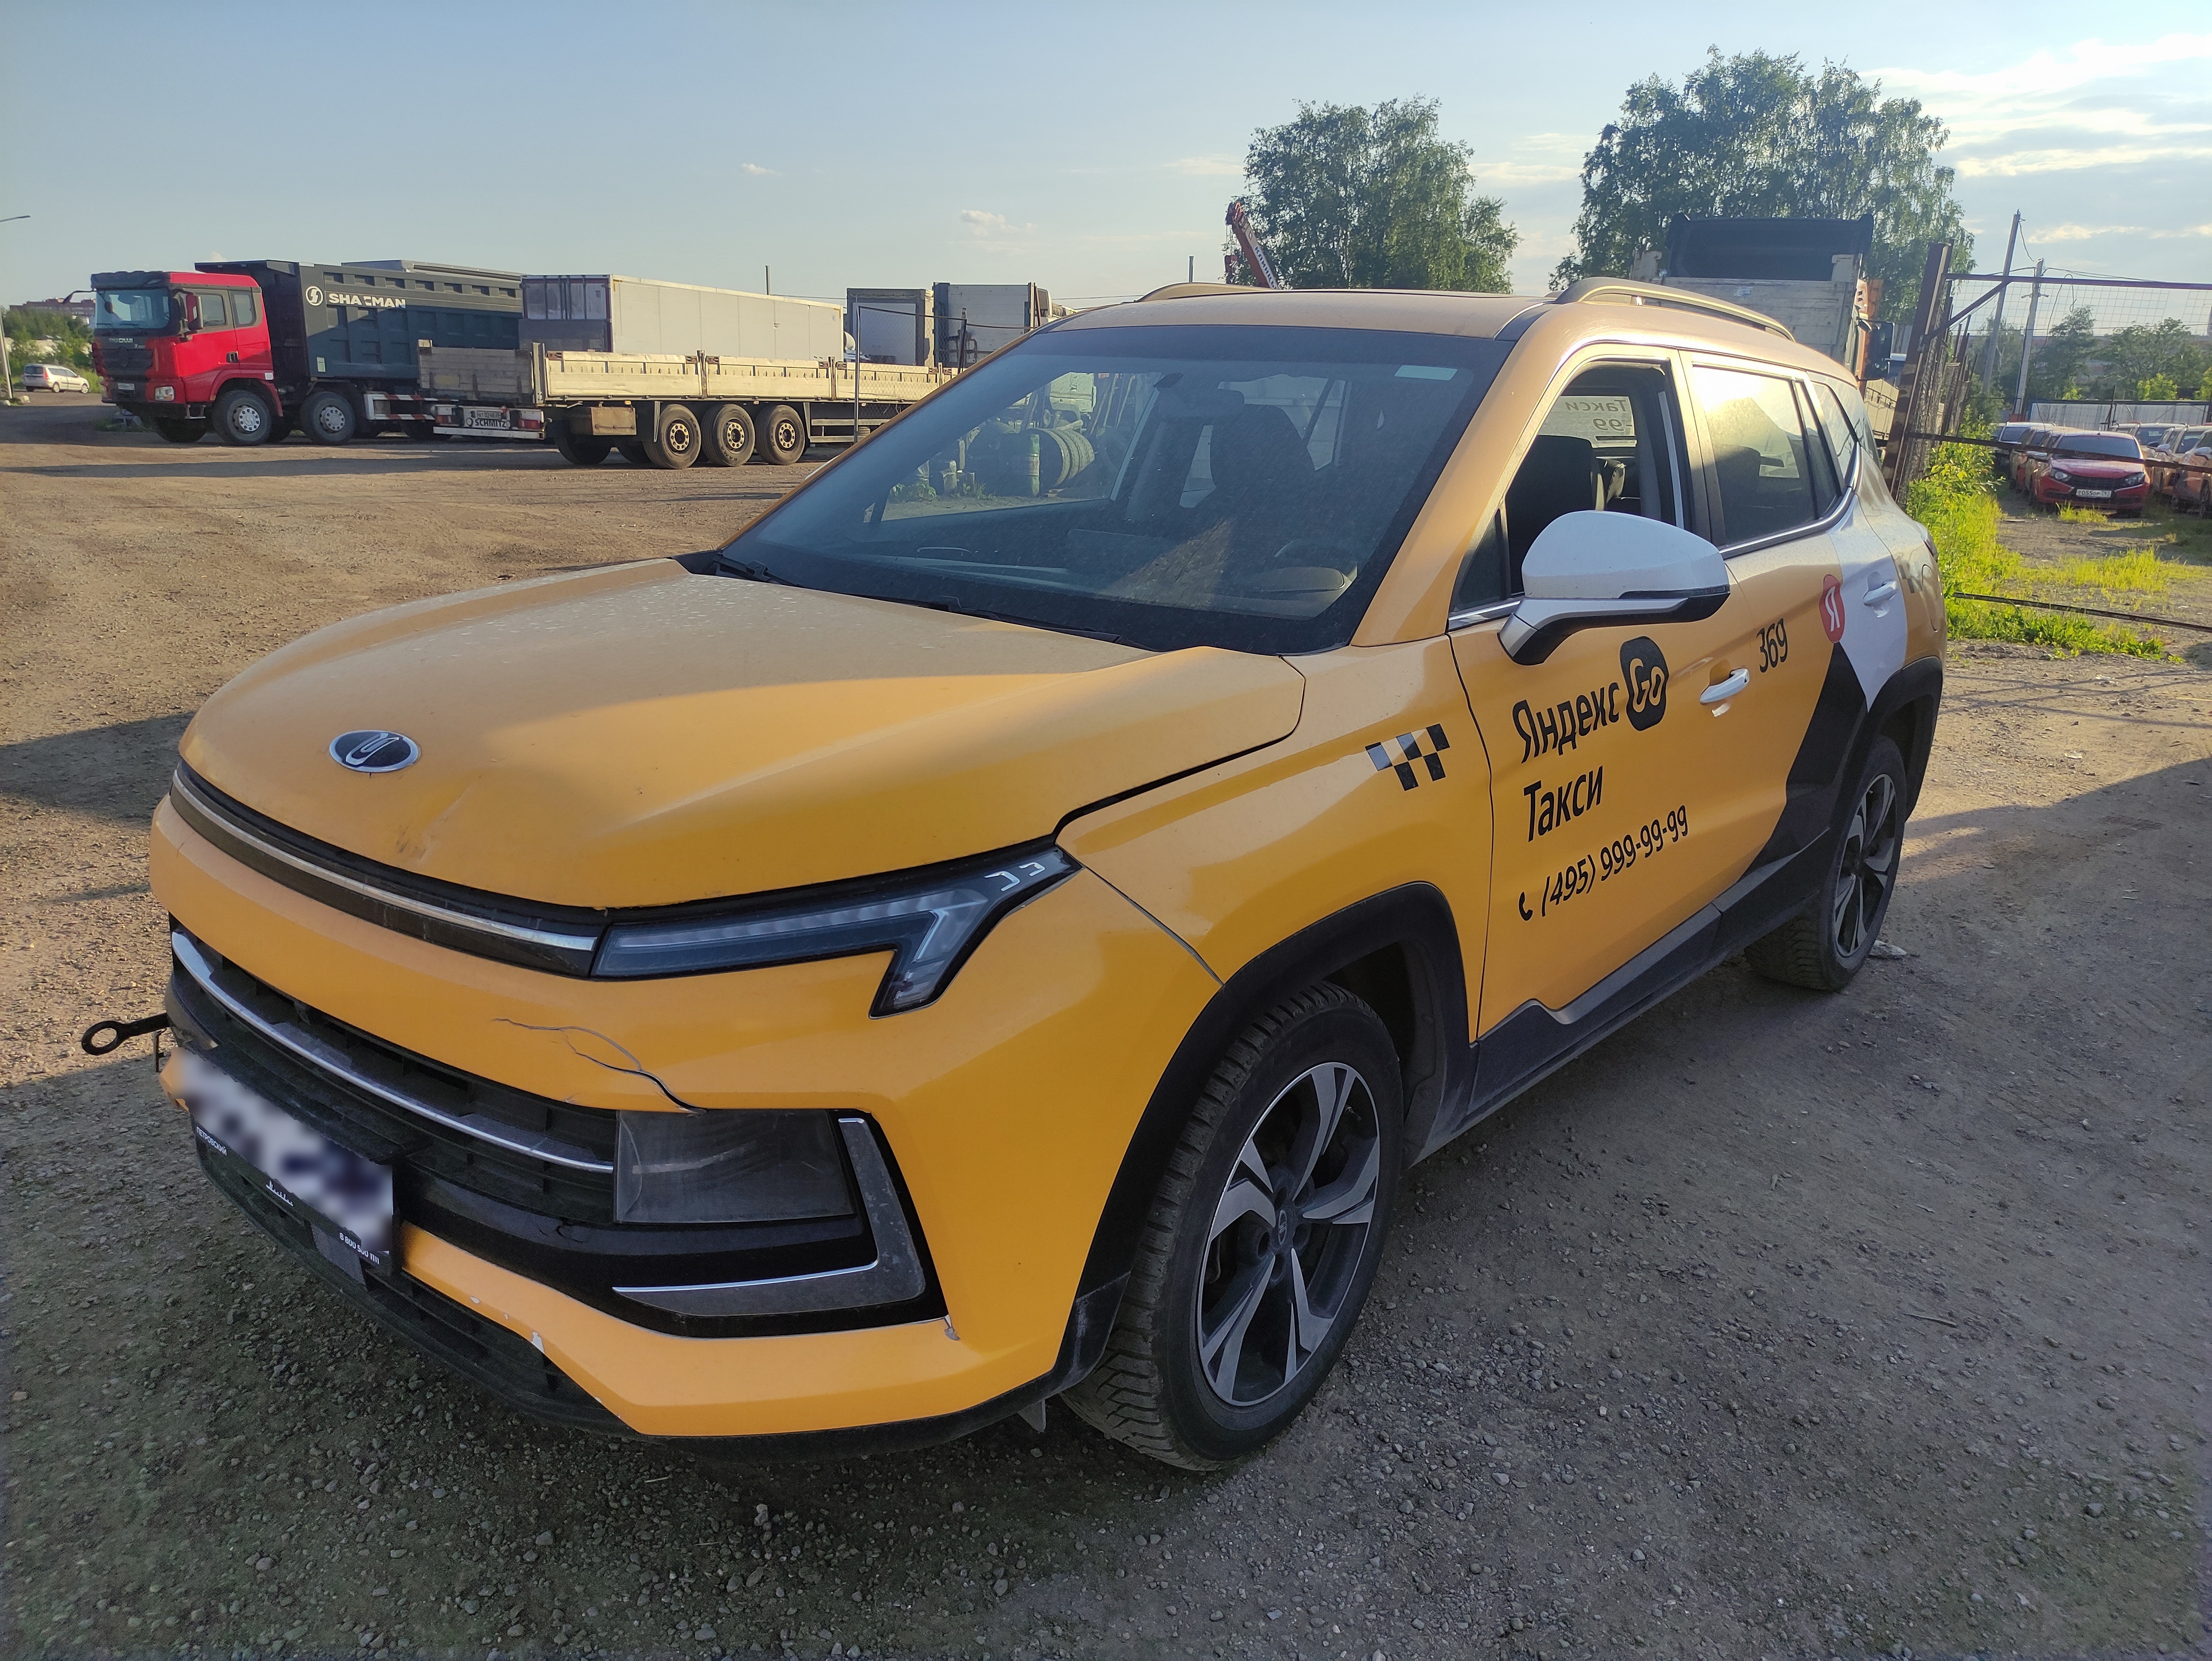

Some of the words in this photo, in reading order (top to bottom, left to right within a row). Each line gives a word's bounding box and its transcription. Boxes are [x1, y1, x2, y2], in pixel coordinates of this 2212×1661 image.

[475, 419, 506, 428] SCHMITZ
[1825, 586, 1840, 632] Я
[1756, 618, 1788, 673] 369
[1512, 682, 1620, 764] Яндекс
[1629, 658, 1665, 713] Go
[1523, 765, 1604, 842] Такси
[1541, 854, 1596, 918] (495)
[1600, 805, 1689, 882] 999-99-99
[196, 1126, 227, 1156] ПЕТРОВСКИЙ
[340, 1232, 344, 1241] 8
[344, 1236, 356, 1249] 800
